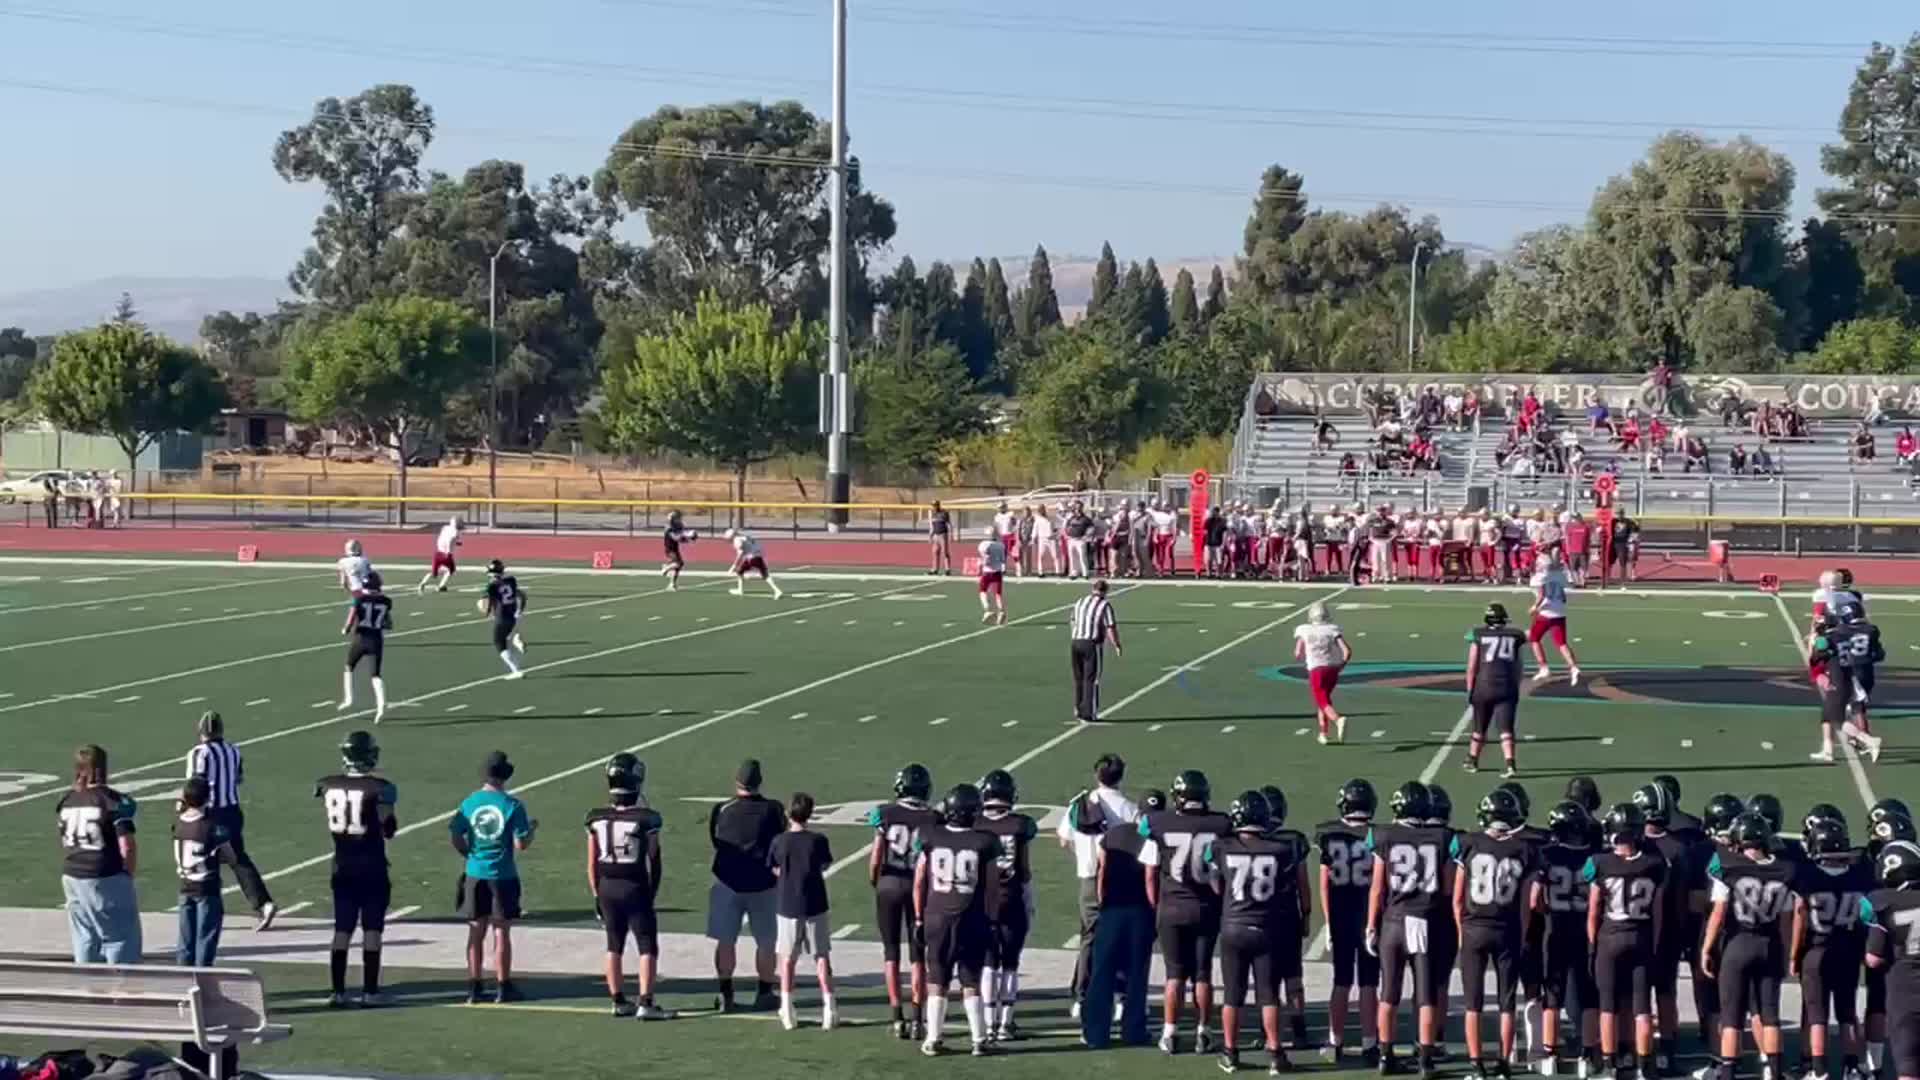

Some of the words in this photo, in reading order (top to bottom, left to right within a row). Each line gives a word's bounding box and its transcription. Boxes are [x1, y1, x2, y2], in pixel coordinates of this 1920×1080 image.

[360, 602, 387, 628] 17
[60, 806, 103, 850] 75
[324, 788, 368, 834] 81
[592, 819, 639, 863] 15
[1226, 855, 1278, 901] 78
[1389, 844, 1438, 893] 31
[1470, 853, 1523, 905] 86
[1605, 877, 1655, 920] 12
